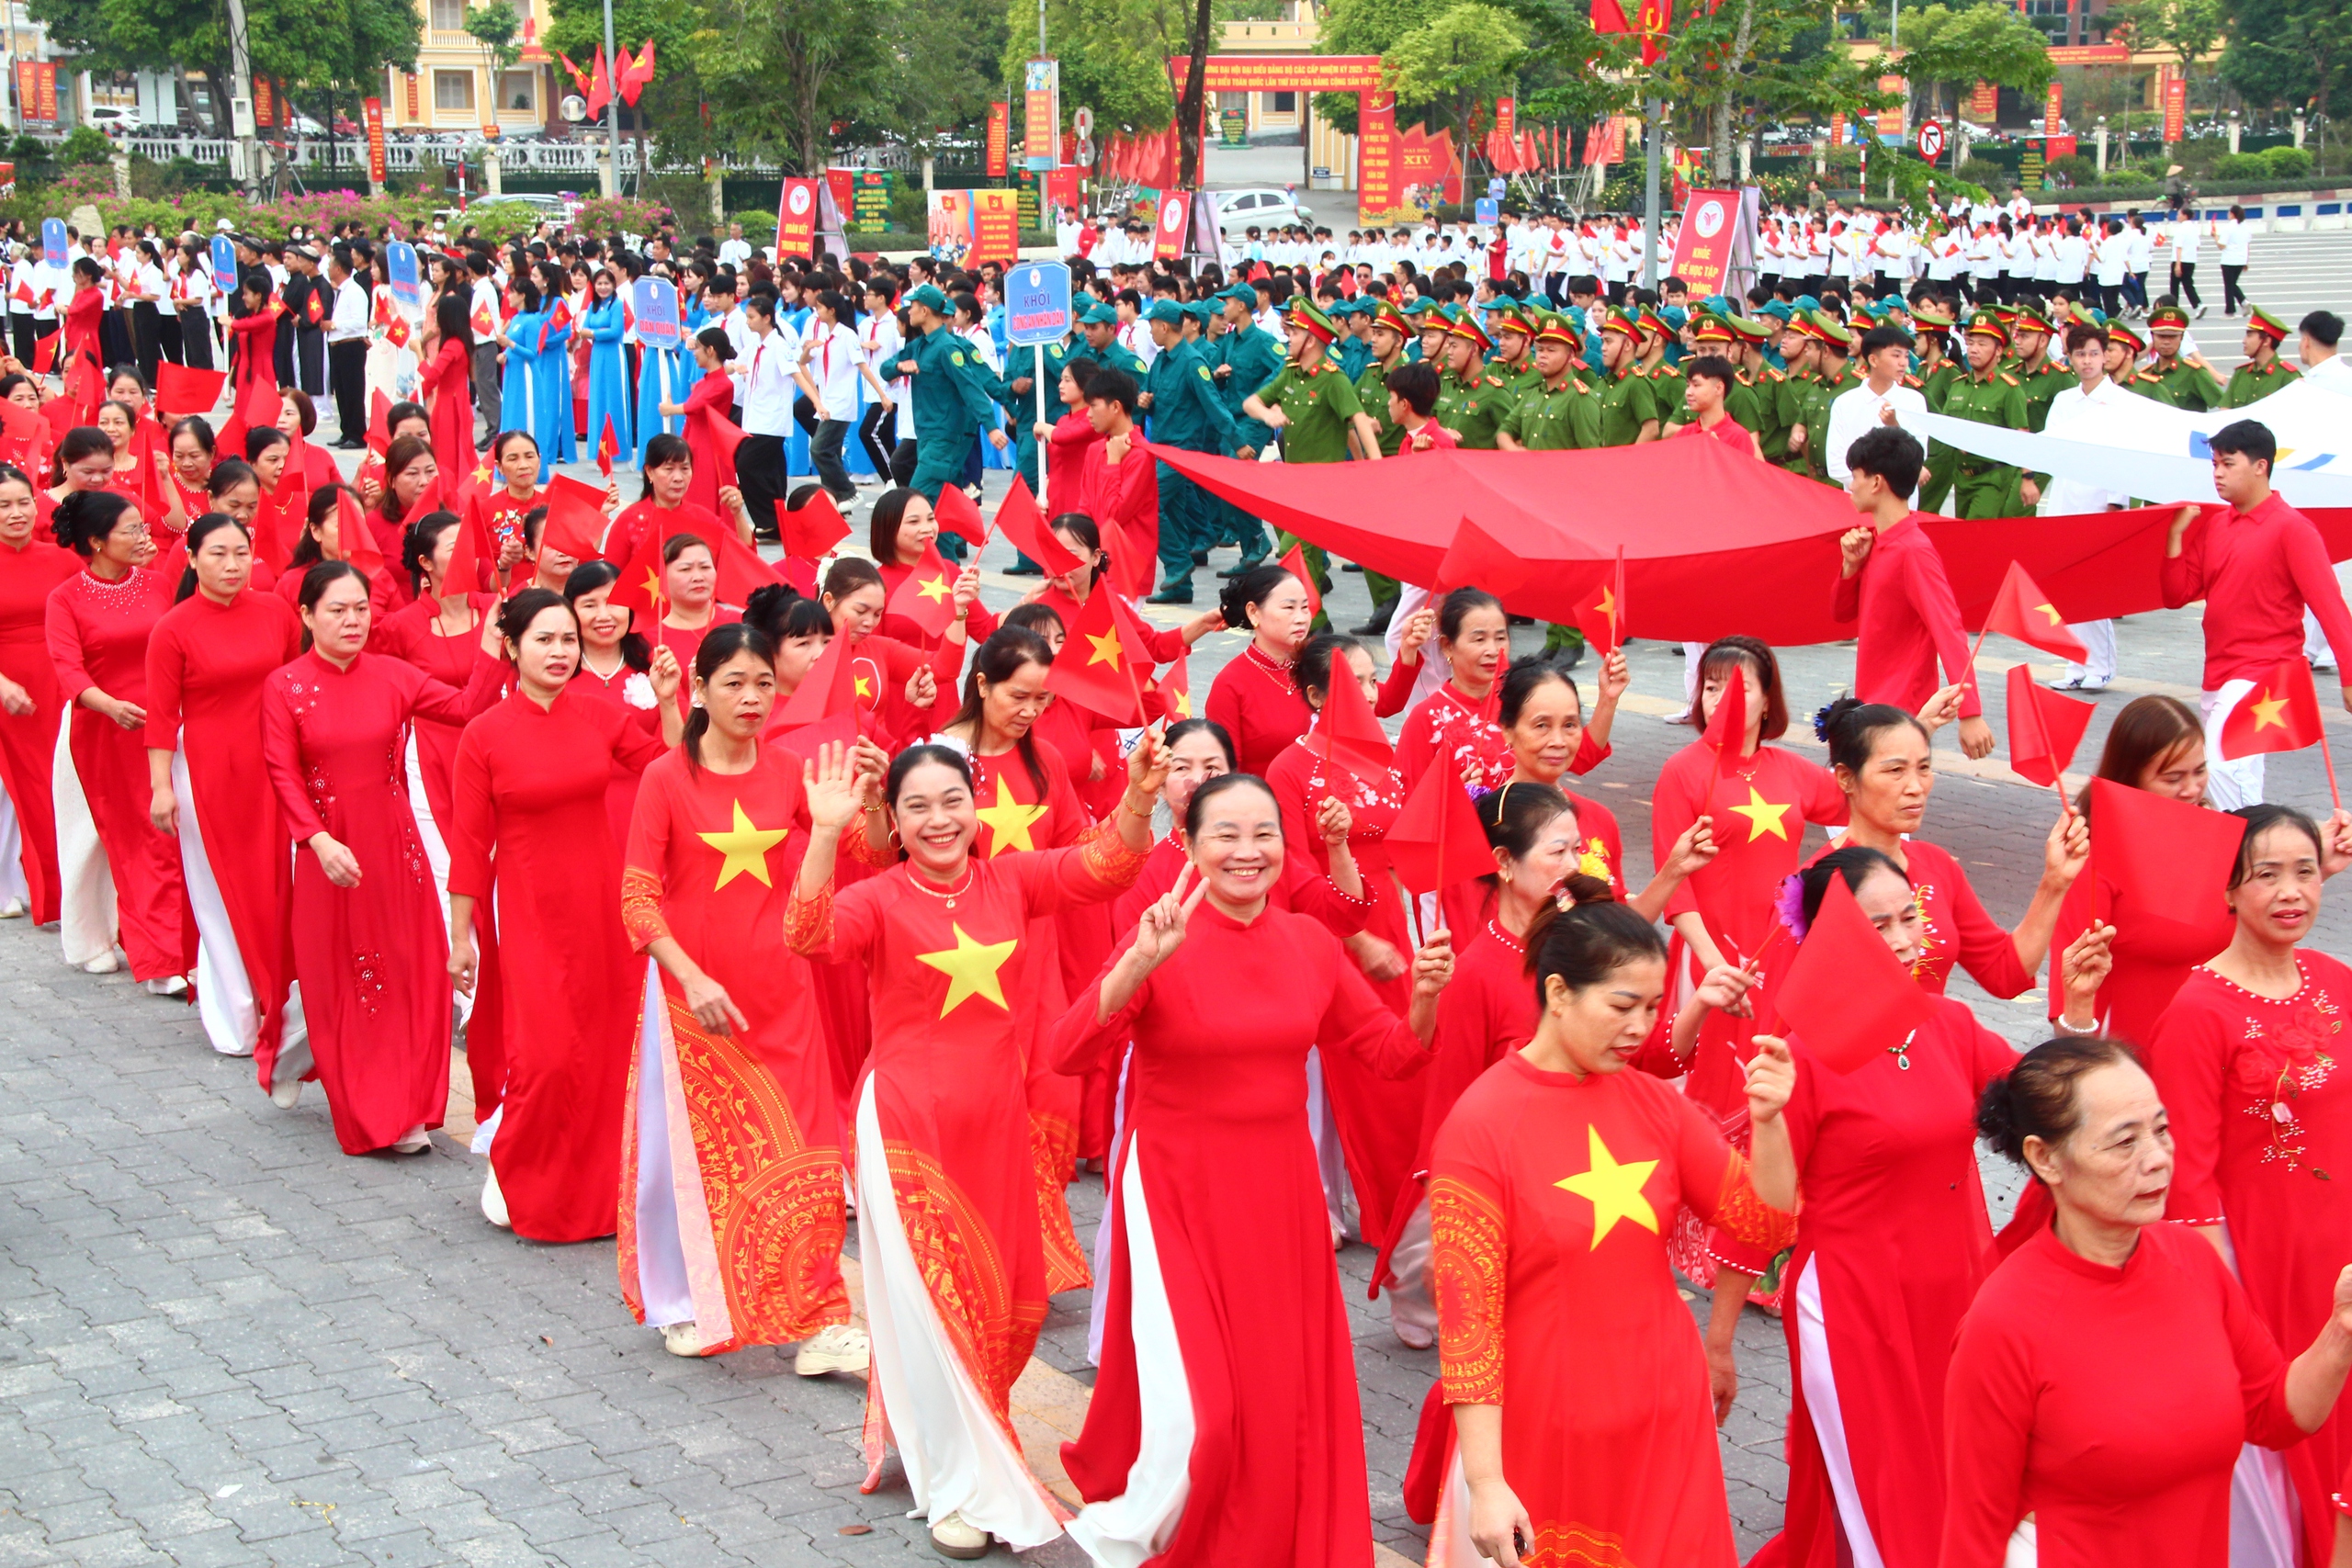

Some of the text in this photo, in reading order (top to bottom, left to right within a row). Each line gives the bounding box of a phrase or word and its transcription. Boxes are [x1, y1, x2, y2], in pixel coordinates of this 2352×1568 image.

[1404, 155, 1431, 164] XIV
[785, 222, 808, 235] ĐOÀN KẾT
[781, 240, 797, 251] TRUNG
[1168, 243, 1177, 254] DÂN
[1692, 244, 1711, 259] KHỎE
[1678, 260, 1719, 279] ĐỂ HỌC TẬP
[1691, 281, 1713, 296] ĐỘNG
[1023, 288, 1050, 307] KHỐI
[647, 301, 665, 316] KHỐI
[639, 317, 676, 335] DÂN QUÂN
[1012, 308, 1064, 331] CÔNG AN NHÂN DÂN
